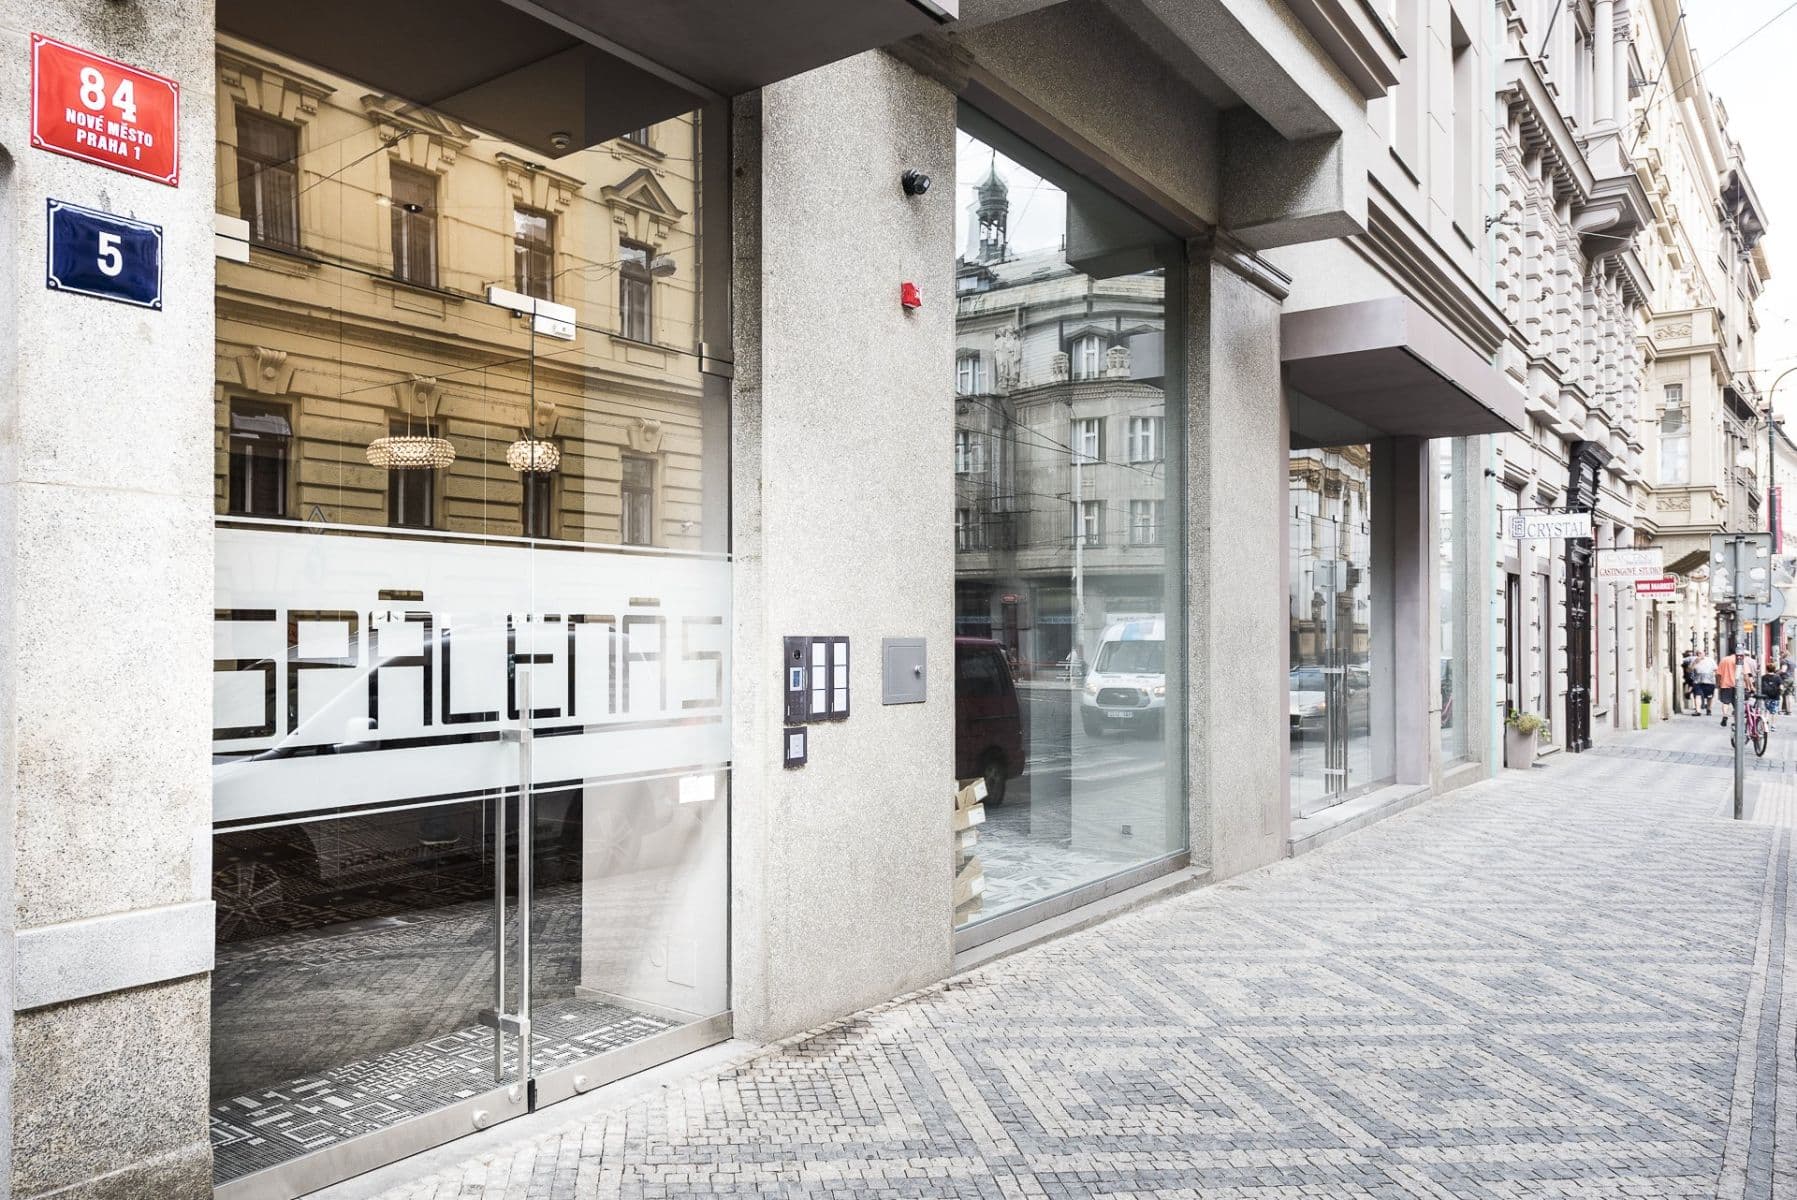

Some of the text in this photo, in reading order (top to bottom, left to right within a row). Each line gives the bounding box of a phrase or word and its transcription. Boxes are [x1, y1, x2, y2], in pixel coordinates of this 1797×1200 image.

[79, 66, 137, 123] 84
[65, 107, 153, 147] NOVÉ MĚSTO
[76, 127, 141, 161] PRAHA 1
[97, 231, 123, 277] 5
[1527, 521, 1588, 538] CRYSTAL
